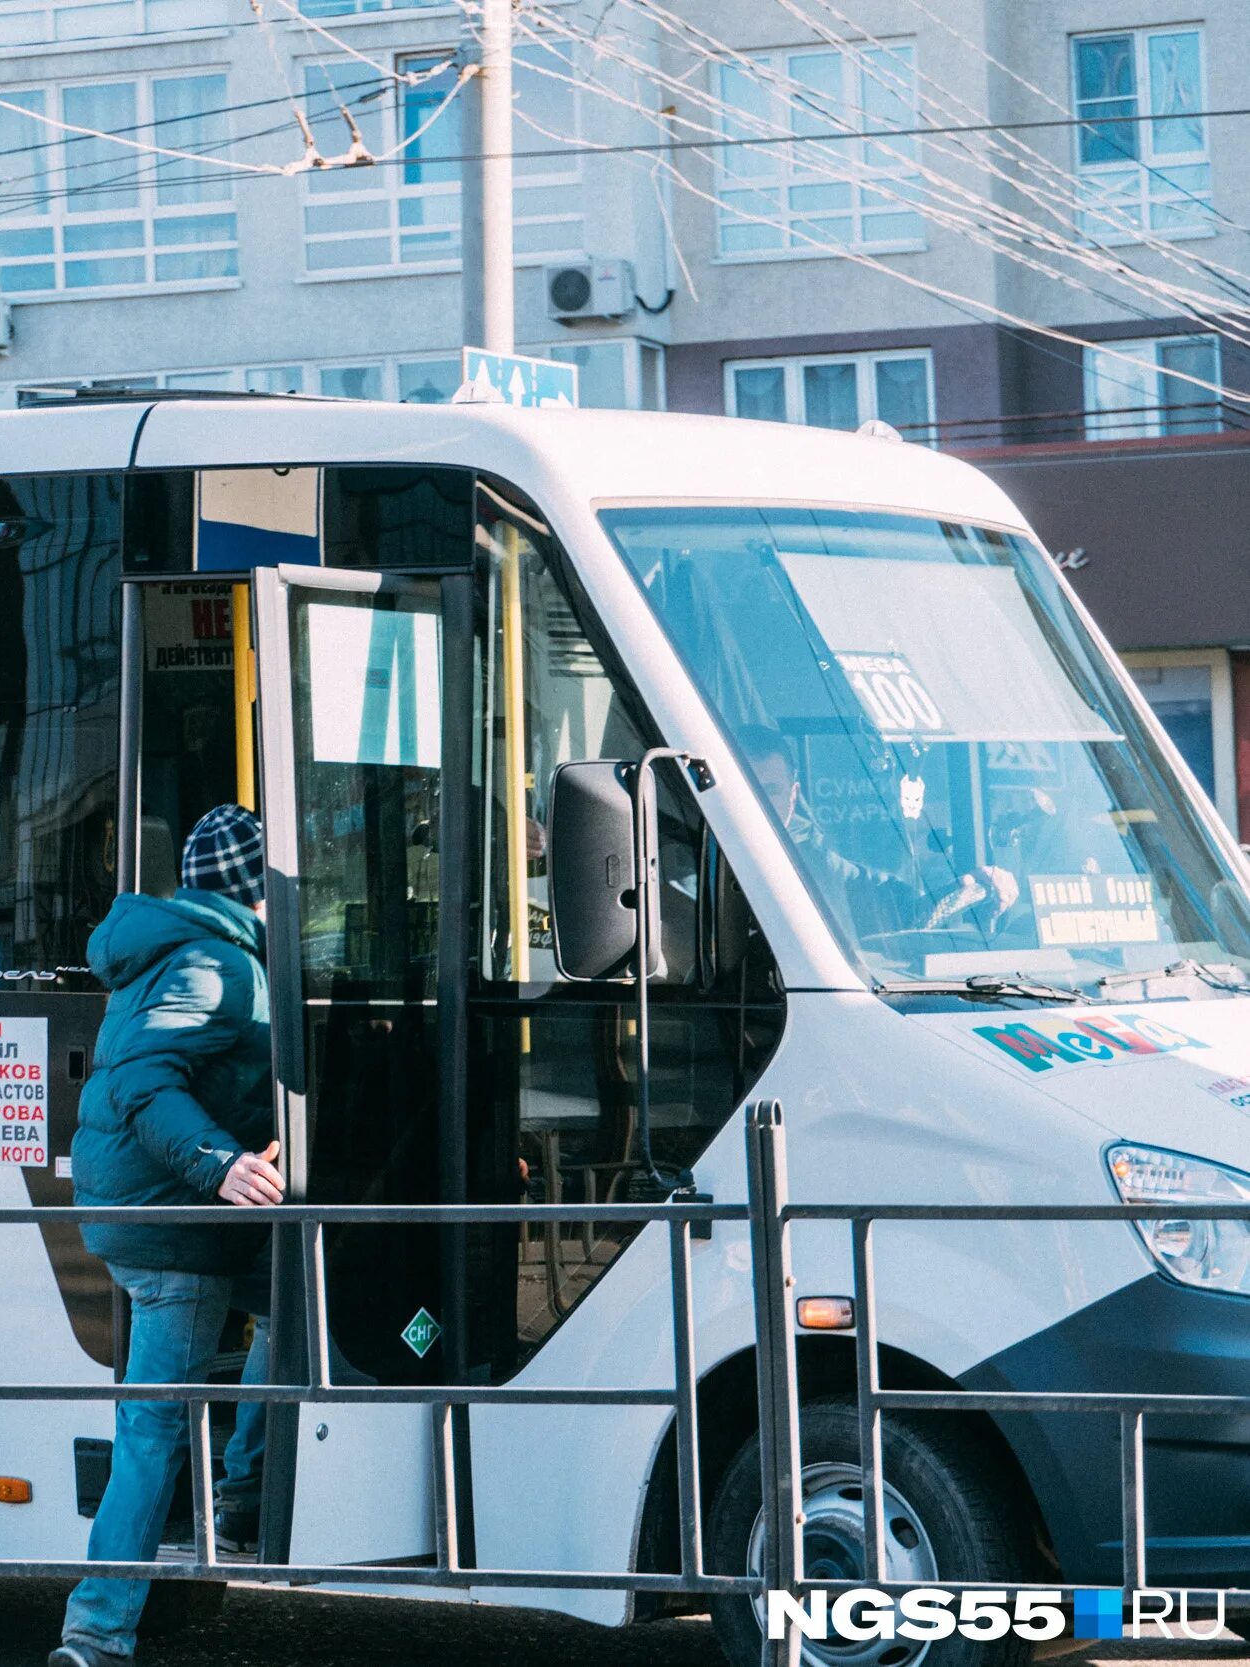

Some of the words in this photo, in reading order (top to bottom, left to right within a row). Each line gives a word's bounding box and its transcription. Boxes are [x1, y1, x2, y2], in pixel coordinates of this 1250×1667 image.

[191, 600, 231, 639] НЕ
[155, 644, 234, 668] ДЕЙСТВИТ
[852, 671, 942, 729] 100
[408, 1324, 434, 1342] СНГ
